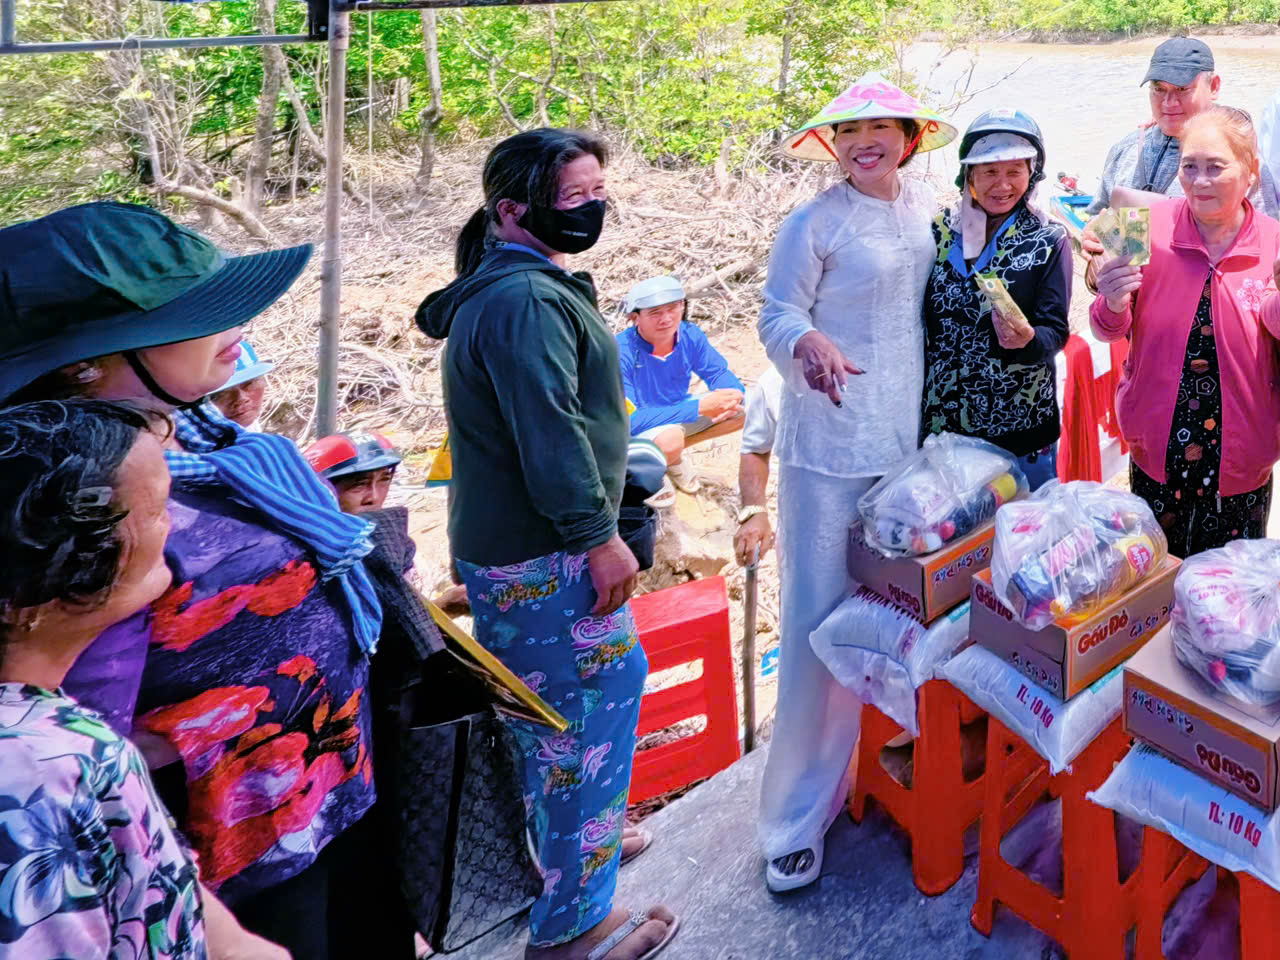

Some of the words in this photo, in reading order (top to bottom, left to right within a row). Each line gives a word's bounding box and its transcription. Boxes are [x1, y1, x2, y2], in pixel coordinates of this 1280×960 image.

[1030, 696, 1041, 716] 10
[1041, 706, 1054, 729] Kg
[1228, 813, 1243, 835] 10
[1244, 821, 1262, 848] Kg
